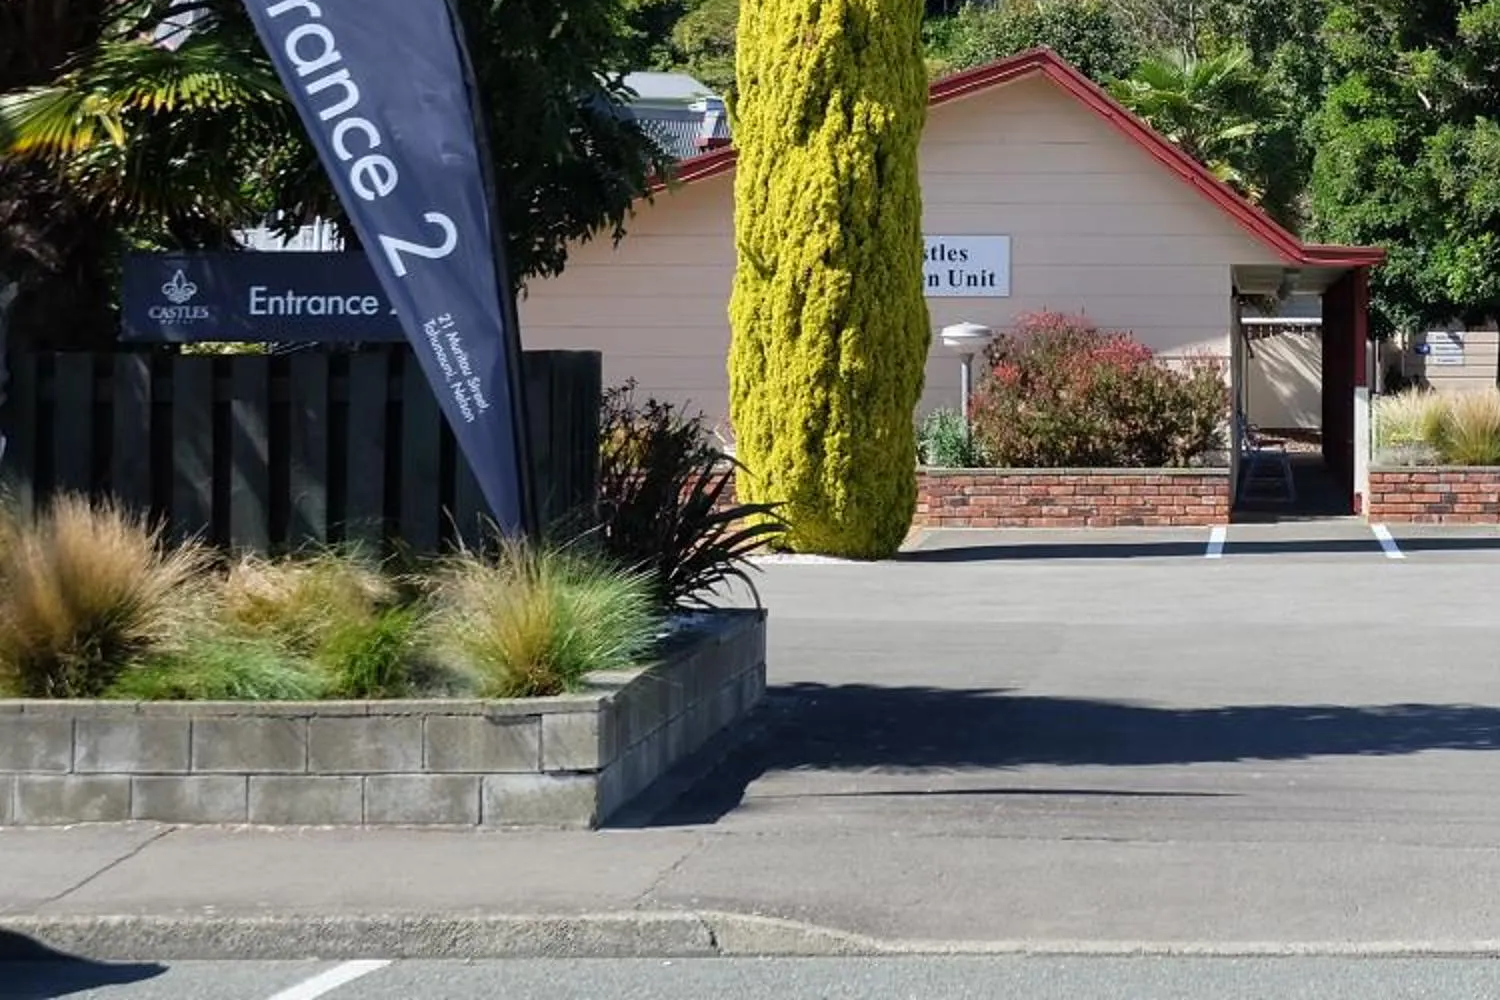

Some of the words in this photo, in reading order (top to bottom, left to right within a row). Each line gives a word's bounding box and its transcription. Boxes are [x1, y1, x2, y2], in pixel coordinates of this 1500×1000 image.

[379, 212, 458, 278] 2
[948, 269, 996, 288] Unit
[250, 286, 380, 316] Entrance
[147, 305, 209, 319] CASTLES
[438, 313, 455, 329] 21
